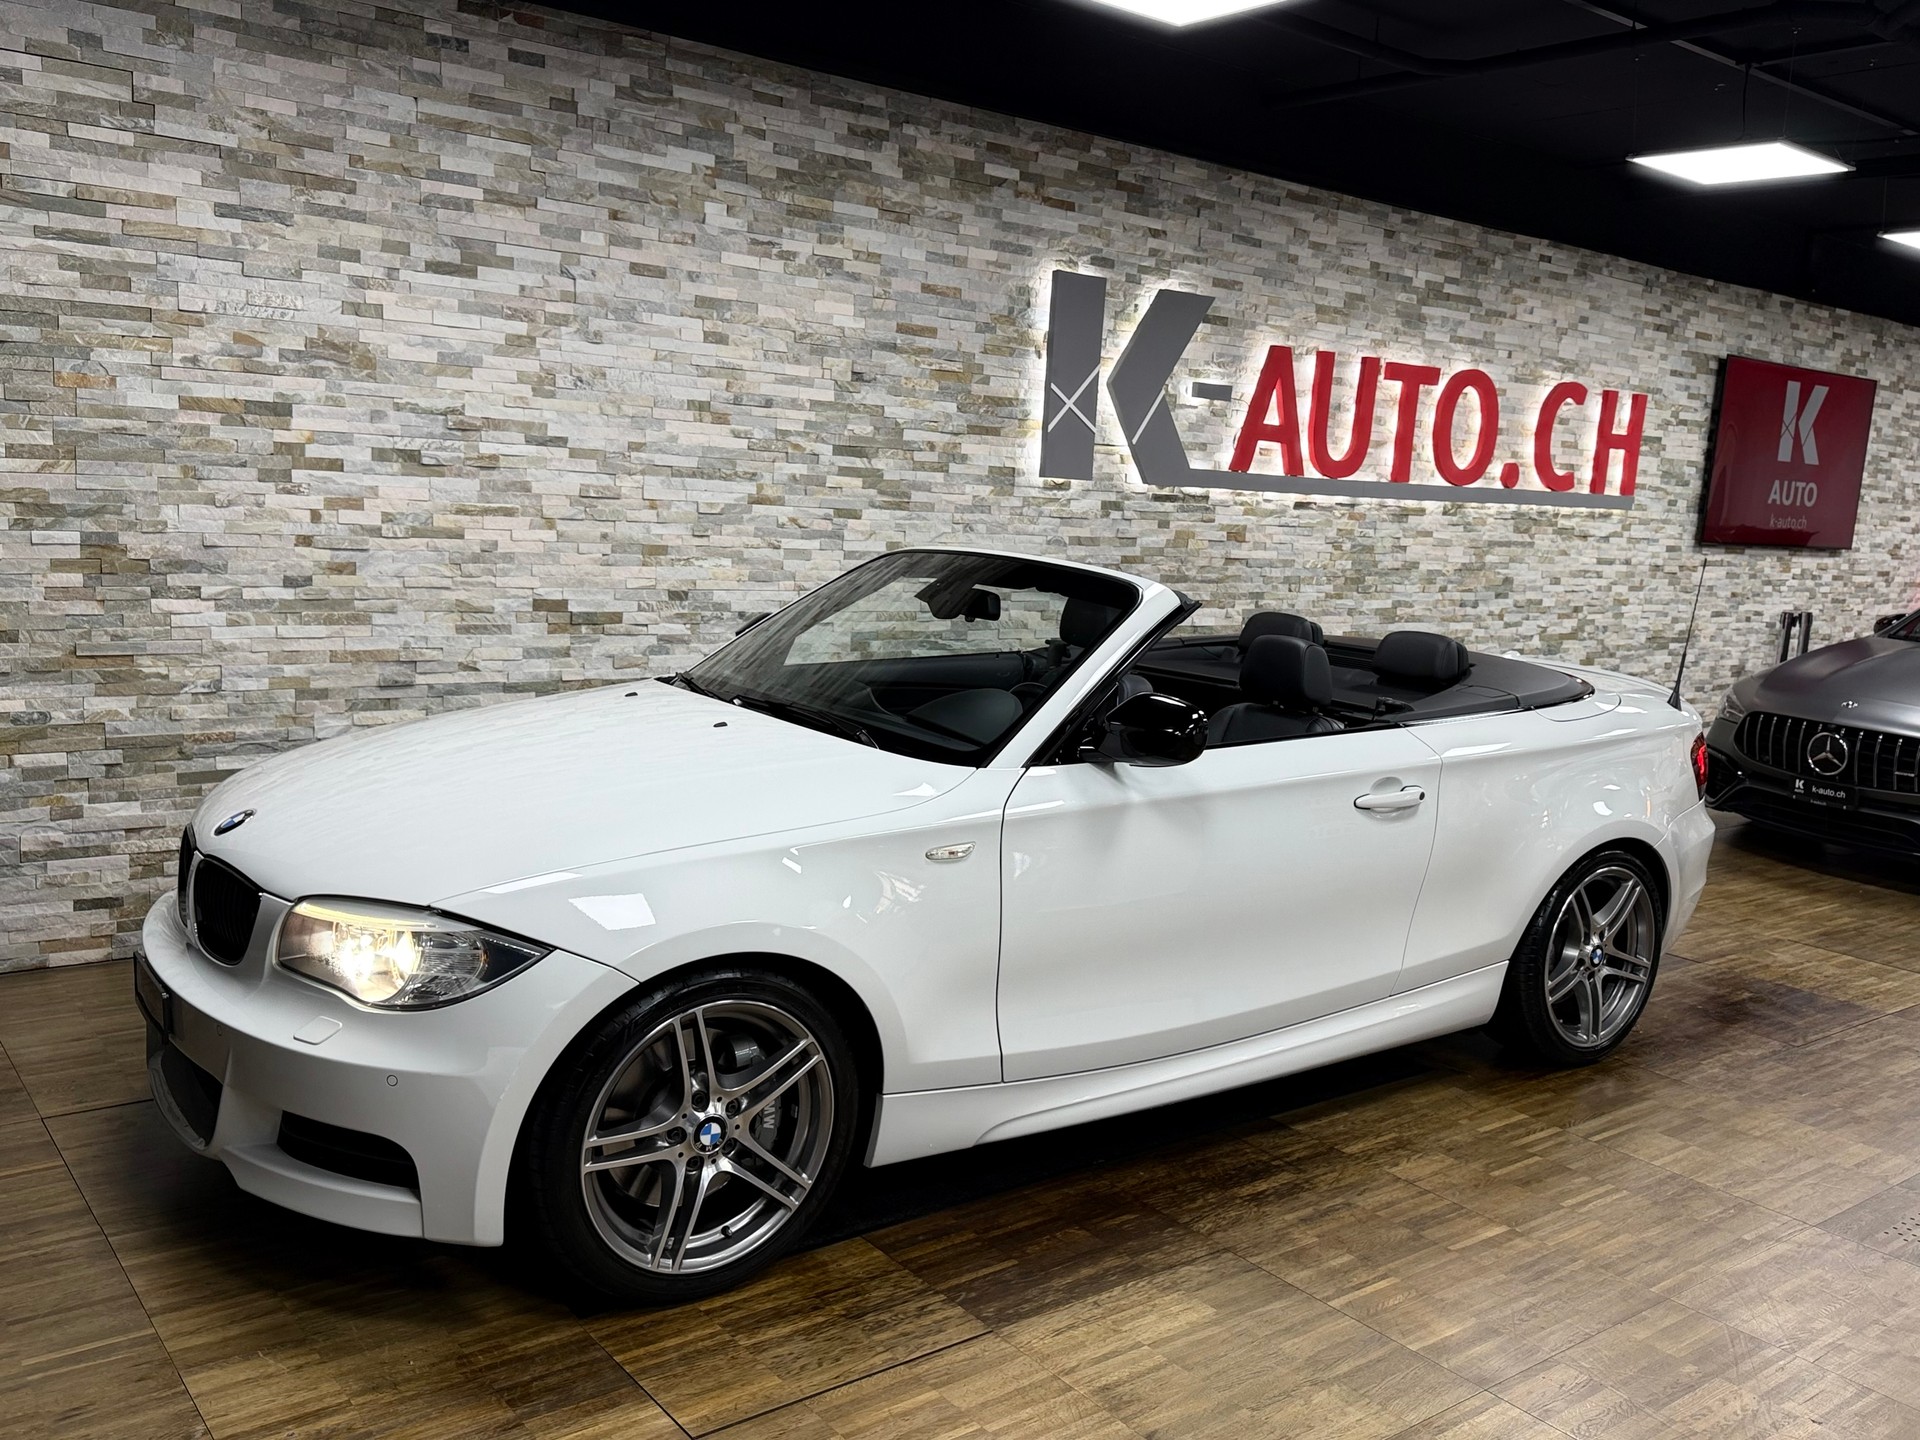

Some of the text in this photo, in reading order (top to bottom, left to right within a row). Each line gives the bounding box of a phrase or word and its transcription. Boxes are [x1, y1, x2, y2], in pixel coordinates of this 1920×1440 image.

[1039, 269, 1648, 497] K-AUTO.CH
[1777, 380, 1830, 466] K
[1767, 479, 1818, 508] AUTO
[1769, 512, 1808, 530] k-auto.ch
[1812, 785, 1846, 798] k-auto.ch
[763, 1100, 776, 1129] MW
